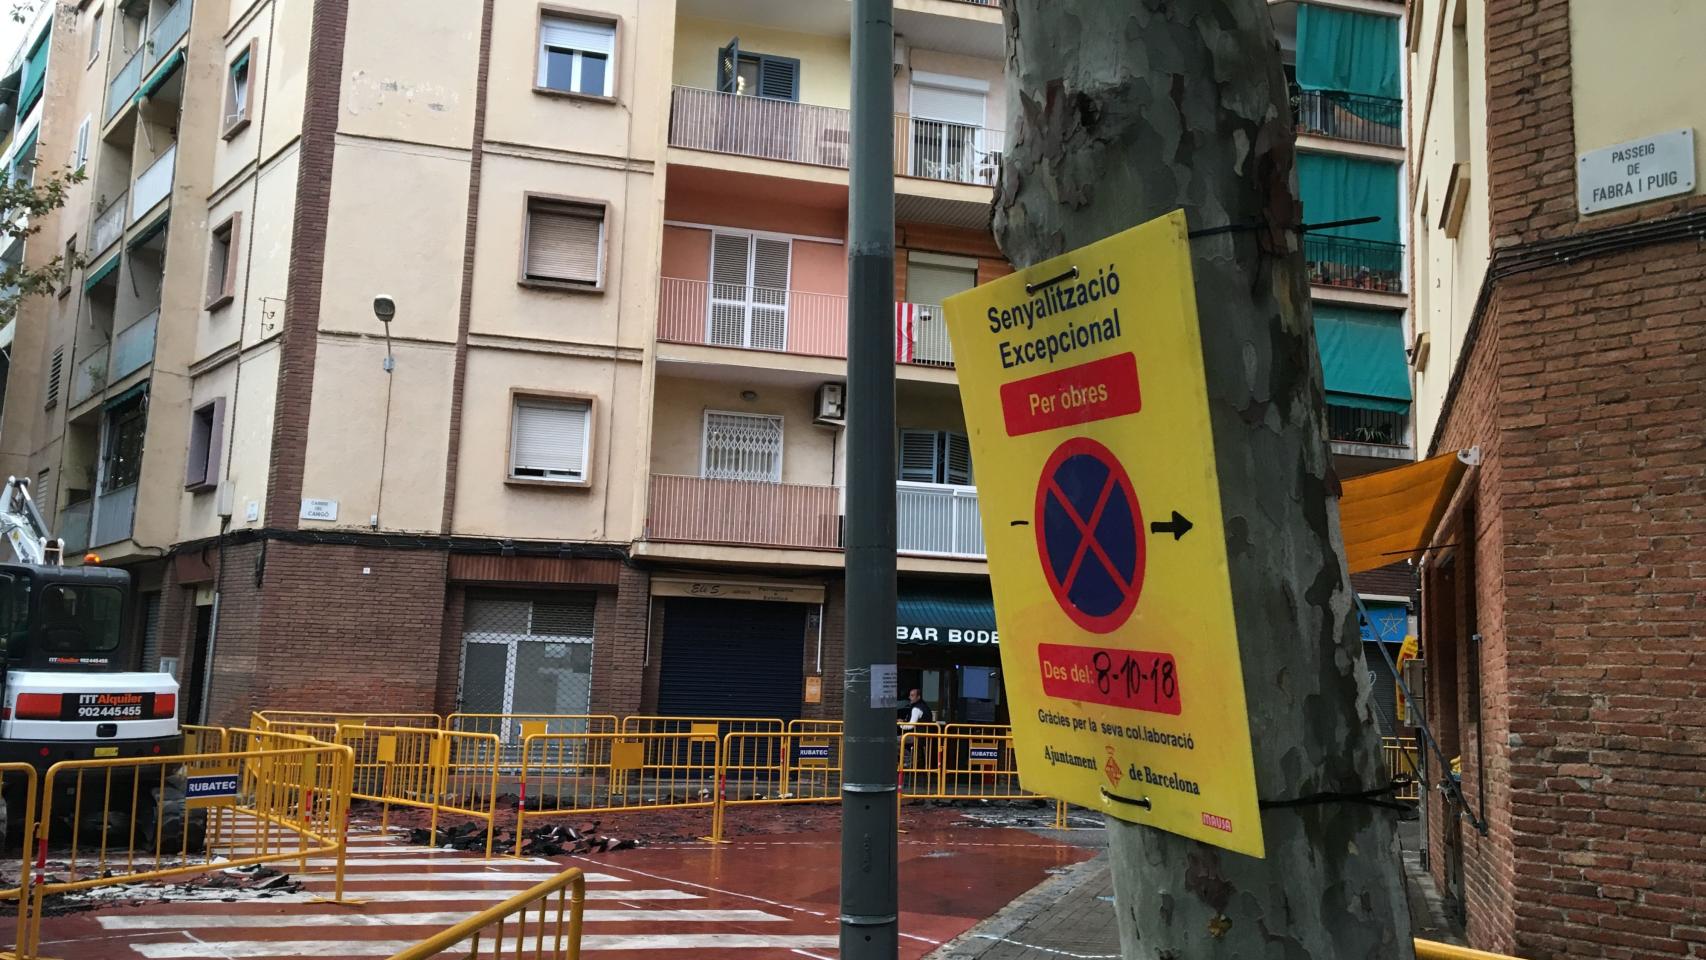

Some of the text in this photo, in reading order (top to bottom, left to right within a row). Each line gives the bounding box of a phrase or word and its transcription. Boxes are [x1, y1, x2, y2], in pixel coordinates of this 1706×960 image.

[1611, 142, 1656, 164] PASSEIG
[1626, 162, 1641, 177] DE
[1592, 170, 1678, 203] FABRA I PUIG
[987, 263, 1121, 334] Senyalització
[998, 307, 1122, 369] Excepcional
[1029, 383, 1108, 416] Per obres
[896, 626, 938, 641] BAR
[1043, 660, 1095, 685] Des del:
[1092, 651, 1175, 704] 8-10-18
[1038, 708, 1070, 728] Gràcies
[1073, 717, 1087, 732] per
[1088, 717, 1097, 732] la
[1101, 723, 1124, 737] seva
[1044, 745, 1200, 795] Ajuntament de Barcelona
[188, 781, 236, 792] RUBATEC
